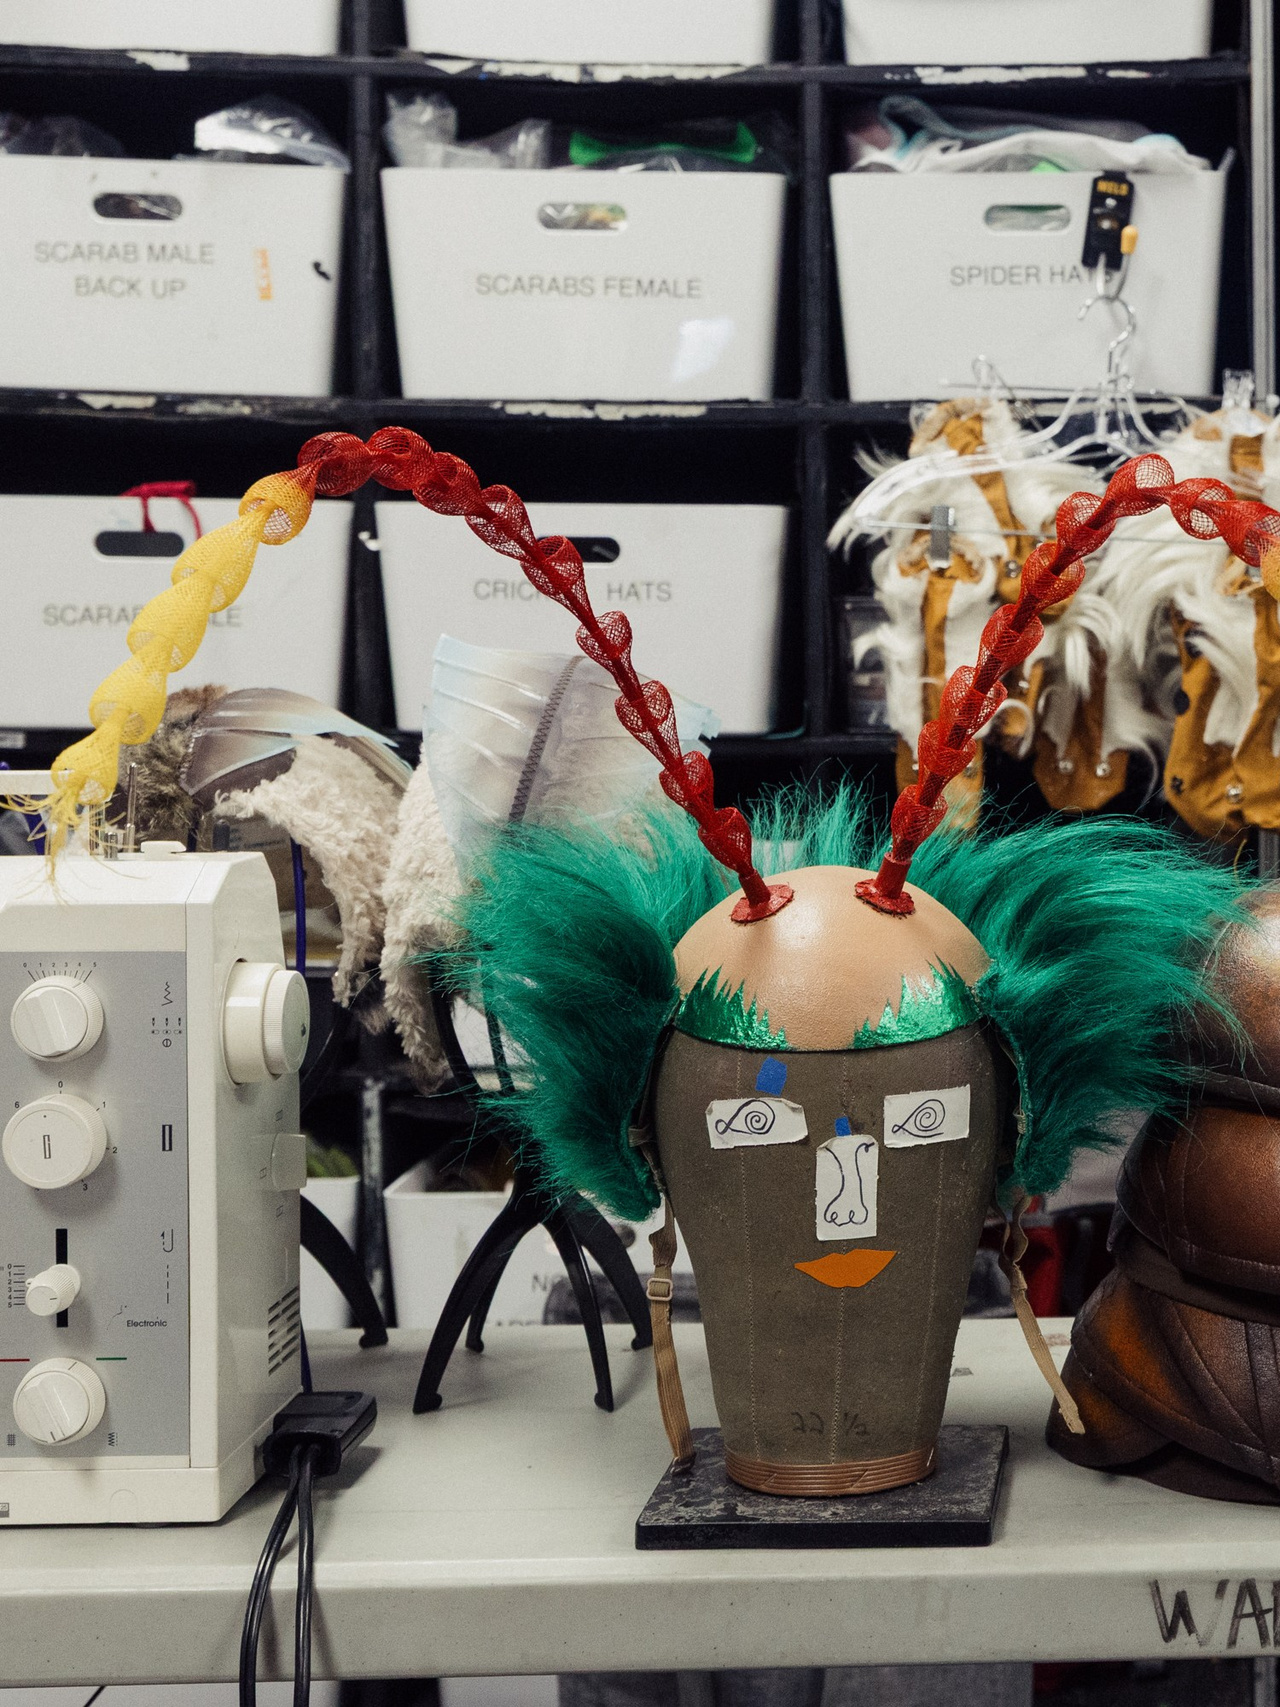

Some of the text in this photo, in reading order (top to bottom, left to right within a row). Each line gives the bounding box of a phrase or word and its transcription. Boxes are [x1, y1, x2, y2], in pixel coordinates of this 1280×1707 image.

[34, 241, 216, 265] SCARAB MALE
[75, 275, 186, 299] BACK UP
[476, 273, 702, 299] SCARABS FEMALE
[950, 265, 1042, 287] SPIDER
[606, 582, 671, 602] HATS
[14, 1101, 20, 1109] 6
[82, 1183, 88, 1191] 3
[126, 1319, 168, 1328] Electronic
[791, 1411, 826, 1434] 22
